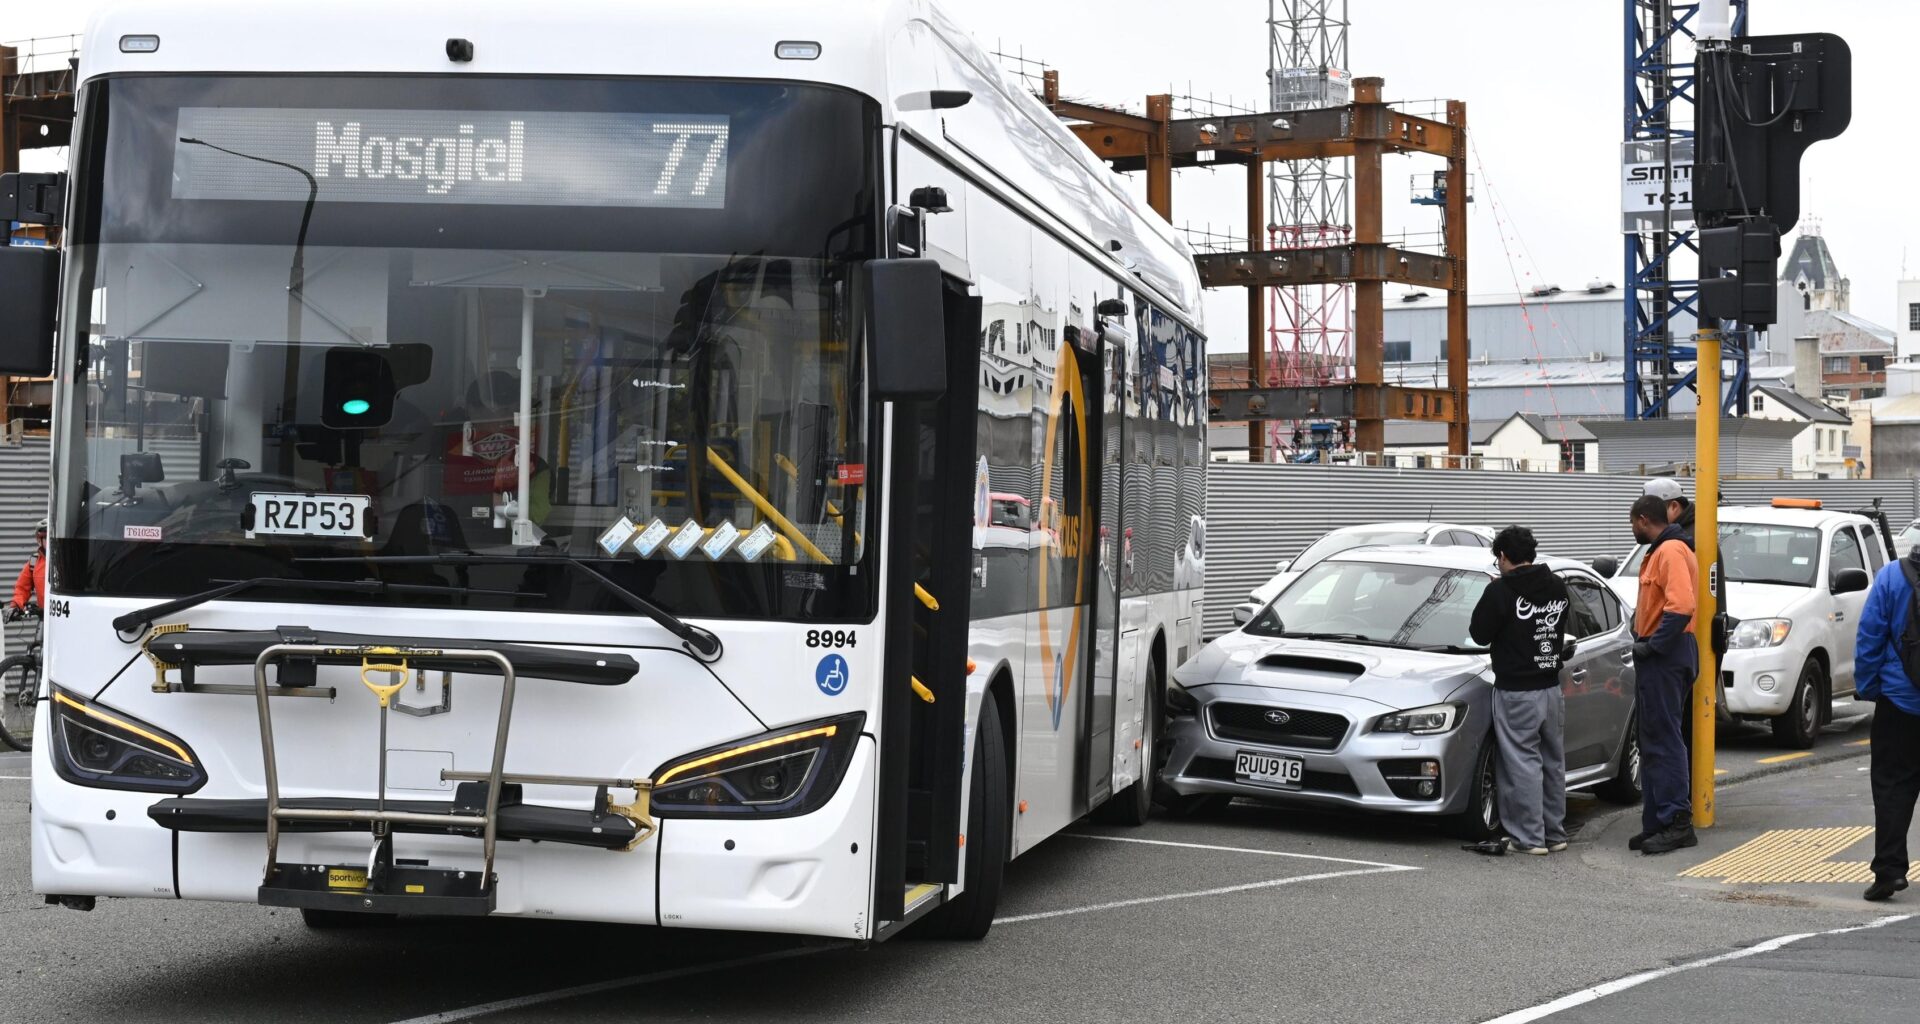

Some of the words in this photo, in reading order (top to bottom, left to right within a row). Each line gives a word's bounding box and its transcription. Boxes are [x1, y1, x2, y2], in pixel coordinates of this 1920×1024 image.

[315, 120, 524, 194] Mosgiel
[653, 123, 729, 195] 77
[264, 499, 356, 531] RZP53
[126, 527, 160, 538] T610253
[805, 629, 857, 648] 8994
[1237, 755, 1300, 779] RUU916
